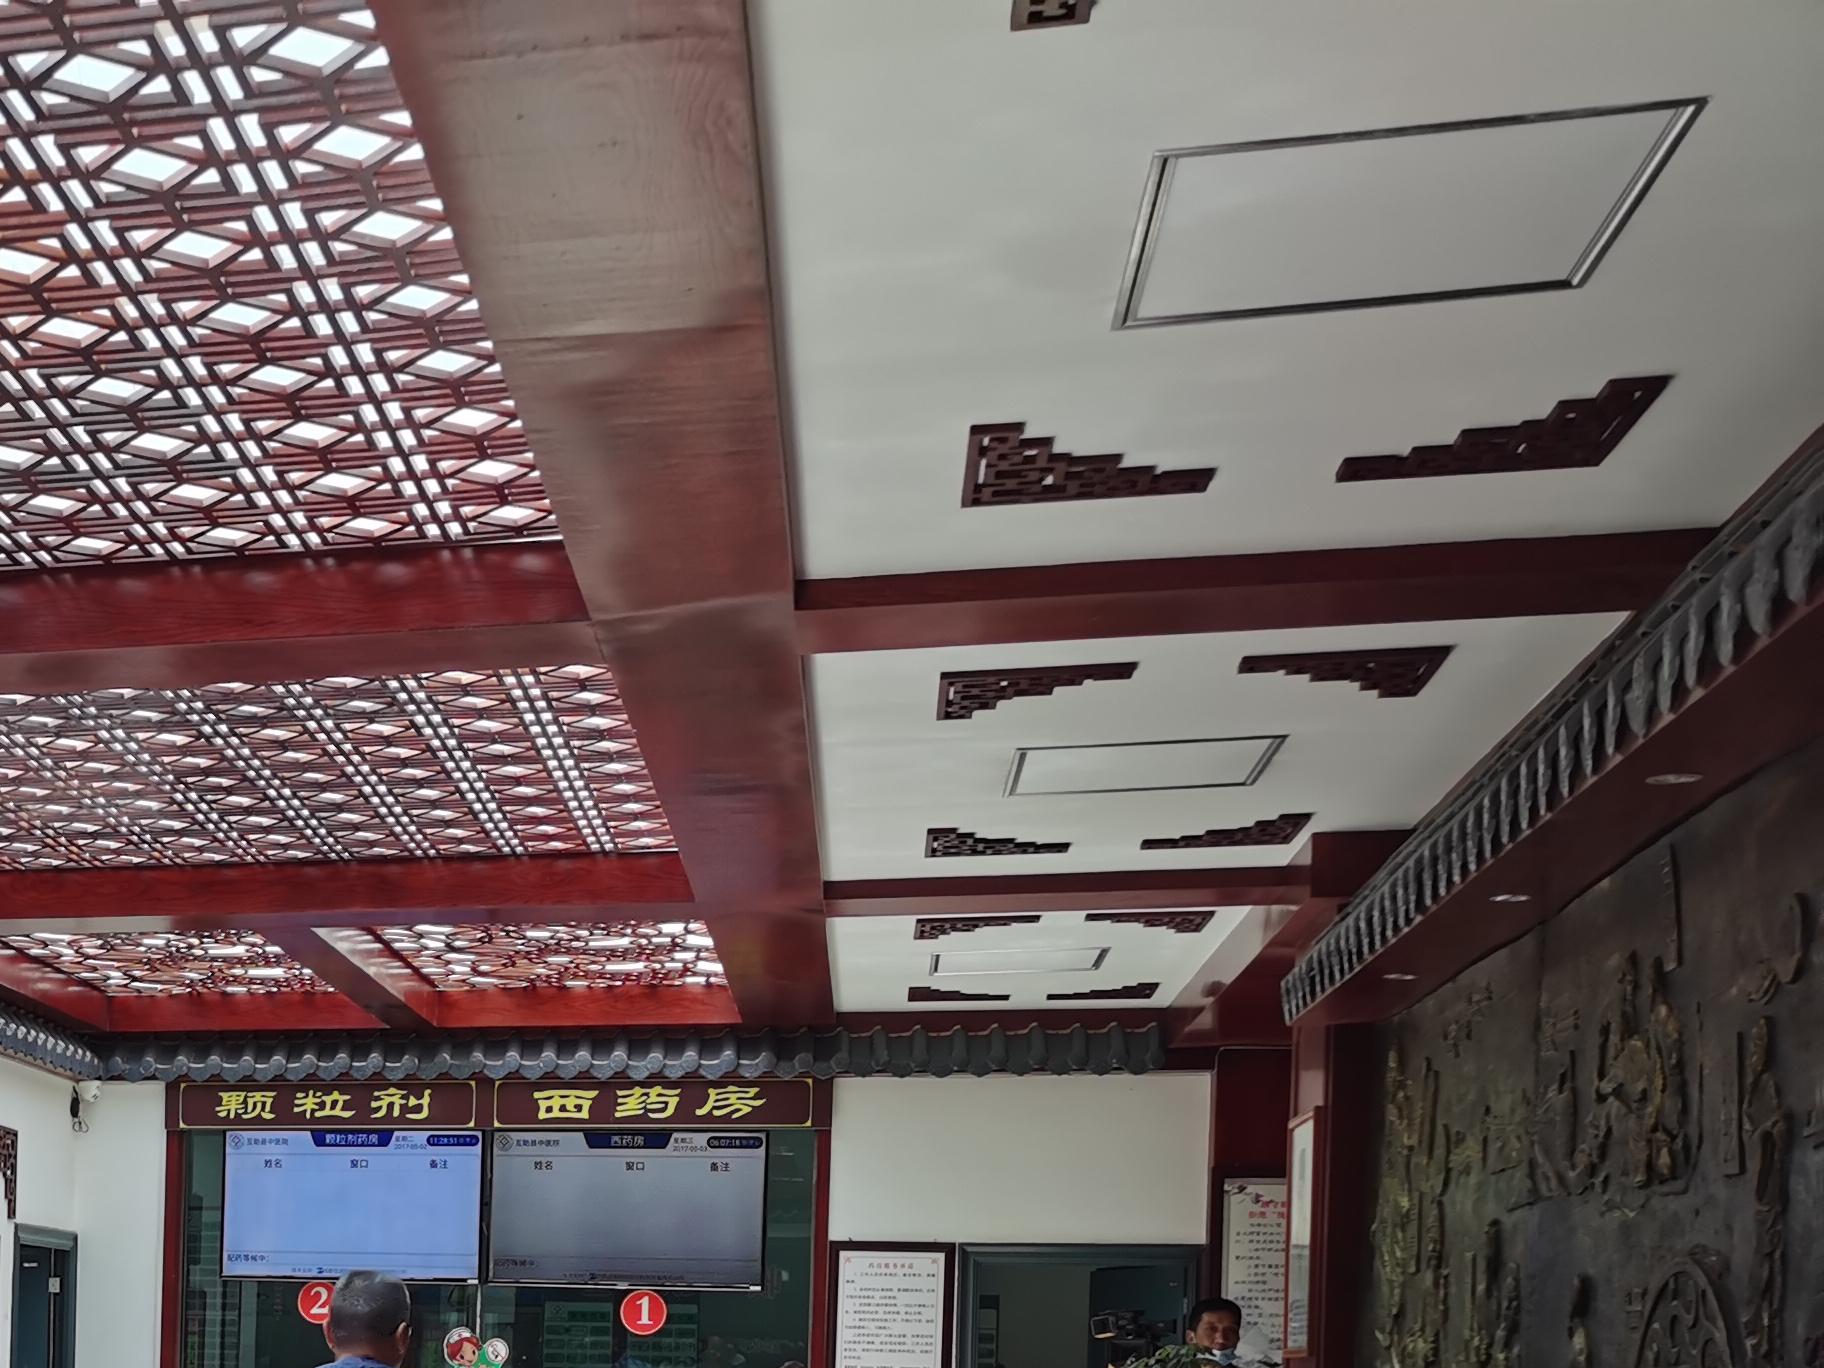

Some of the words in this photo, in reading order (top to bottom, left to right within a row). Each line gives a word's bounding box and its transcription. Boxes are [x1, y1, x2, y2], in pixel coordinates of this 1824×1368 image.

[215, 1087, 432, 1120] 颗粒剂
[533, 1086, 766, 1119] 西药房
[325, 1133, 379, 1146] 颗粒剂药房
[610, 1136, 645, 1147] 西药房
[264, 1159, 283, 1169] 姓名
[350, 1159, 369, 1169] 窗口
[429, 1159, 449, 1170] 备注
[533, 1160, 554, 1171] 姓名
[625, 1161, 646, 1171] 窗口
[709, 1161, 731, 1173] 备注
[309, 1286, 329, 1315] 2
[635, 1295, 654, 1325] 1
